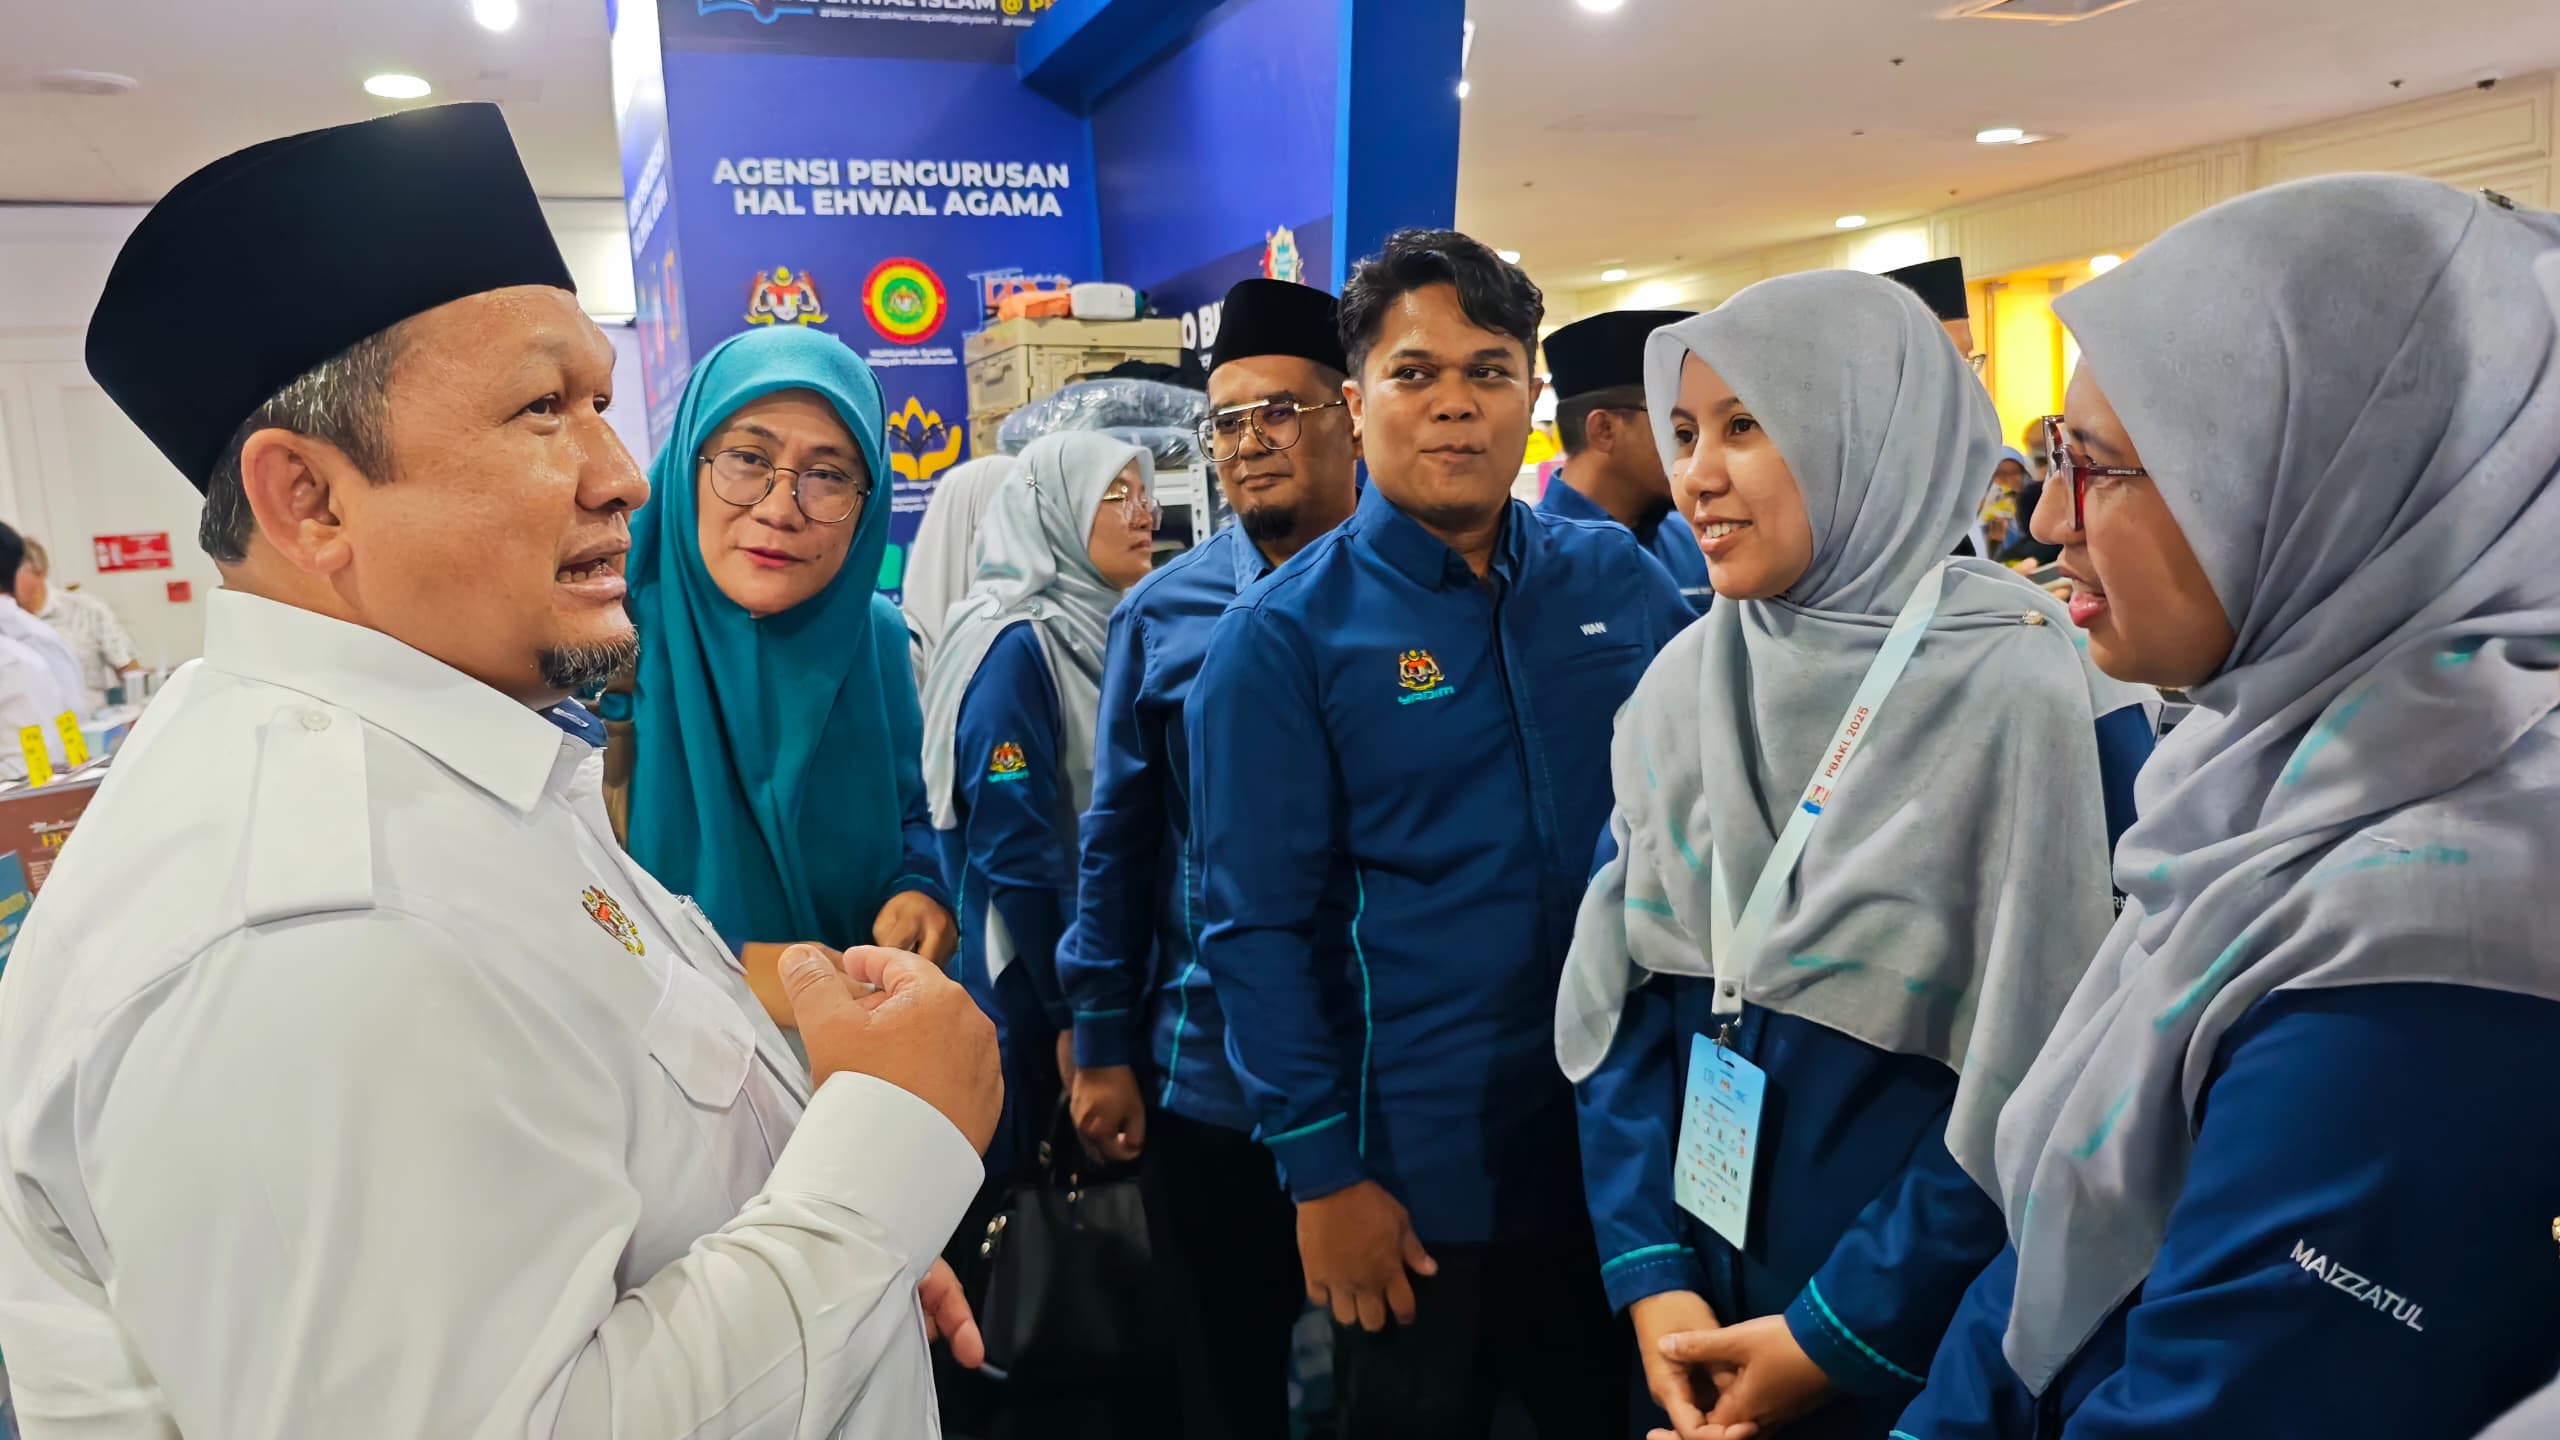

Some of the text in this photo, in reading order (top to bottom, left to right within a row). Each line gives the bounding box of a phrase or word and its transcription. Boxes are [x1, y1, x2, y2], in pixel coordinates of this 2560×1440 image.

[713, 158, 1070, 189] AGENSI PENGURUSAN
[734, 189, 1063, 217] HAL EHWAL AGAMA
[1824, 704, 1870, 779] PBAKL 2025
[2290, 1238, 2424, 1332] MAIZZATUL
